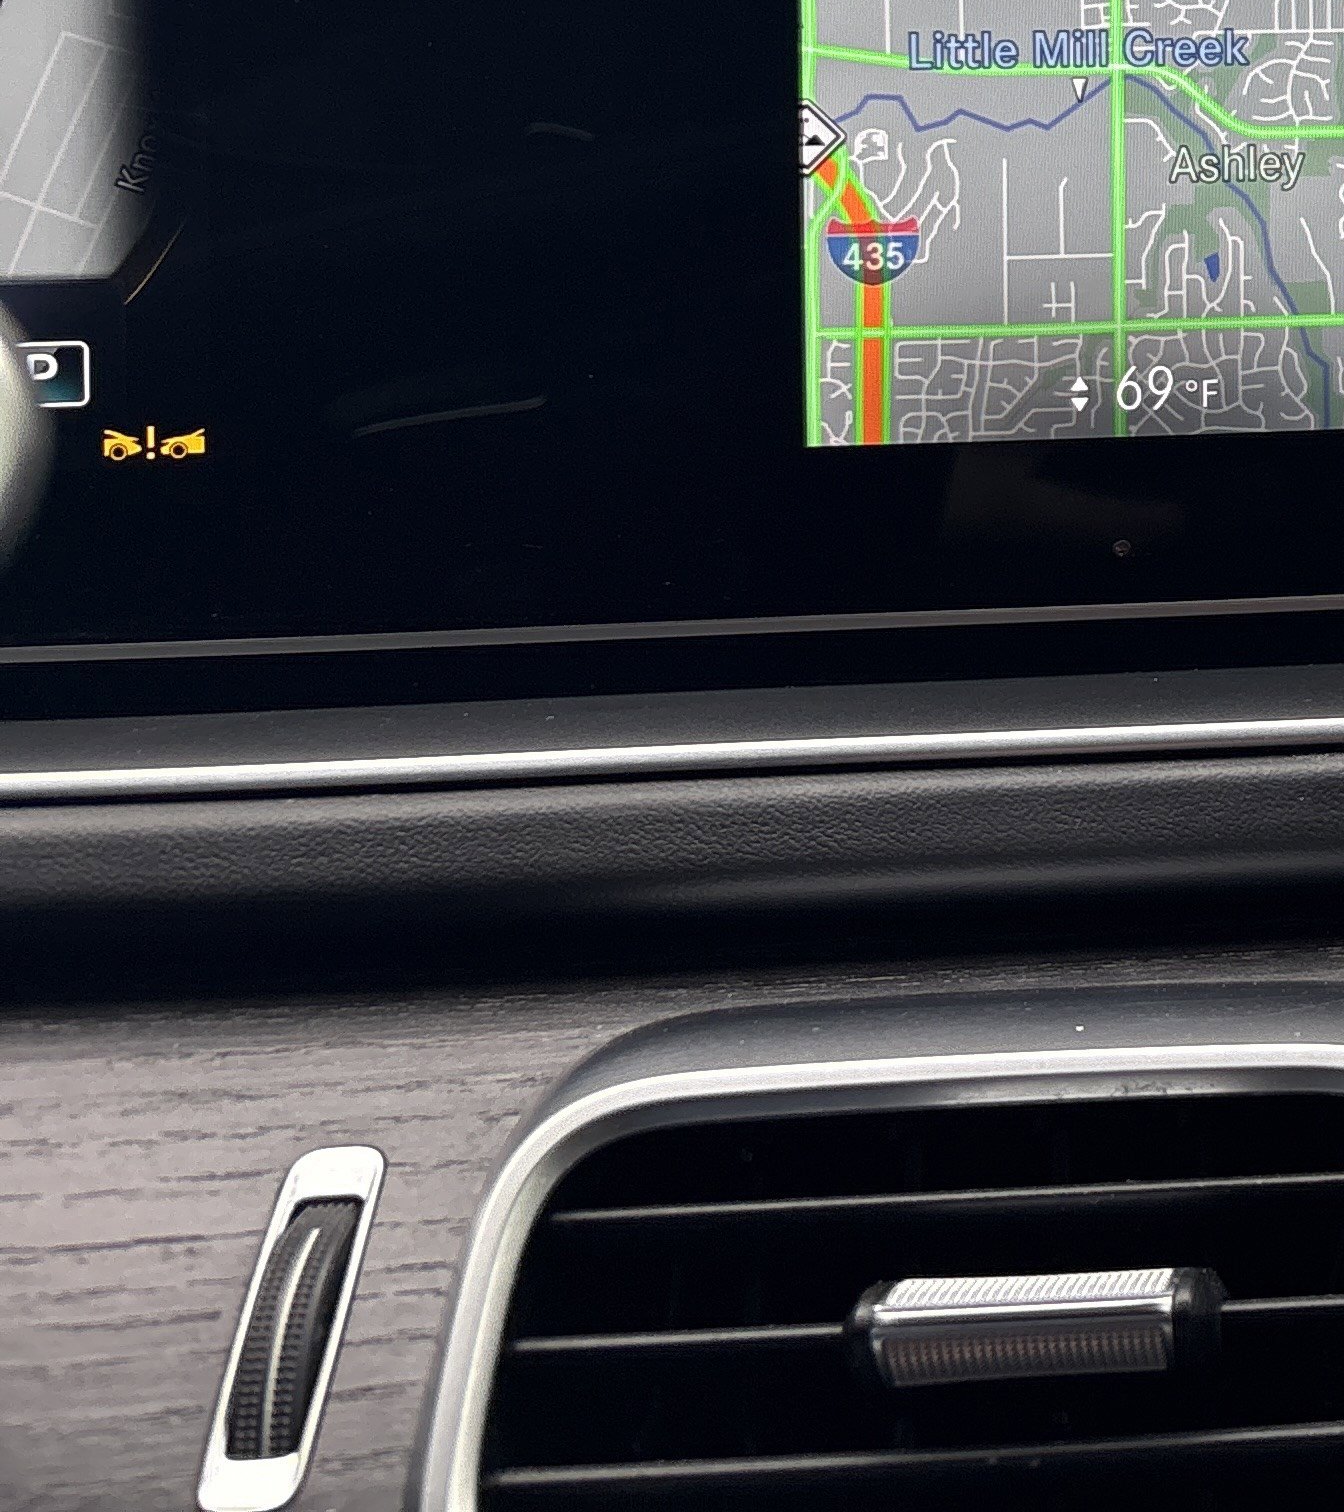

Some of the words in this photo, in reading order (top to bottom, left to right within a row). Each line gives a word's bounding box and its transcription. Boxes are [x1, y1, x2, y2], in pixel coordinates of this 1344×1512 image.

[907, 29, 1018, 71] Little
[1032, 29, 1108, 68] Mill
[1123, 28, 1251, 68] Creek
[1169, 144, 1305, 192] Ashley
[841, 241, 905, 271] 435
